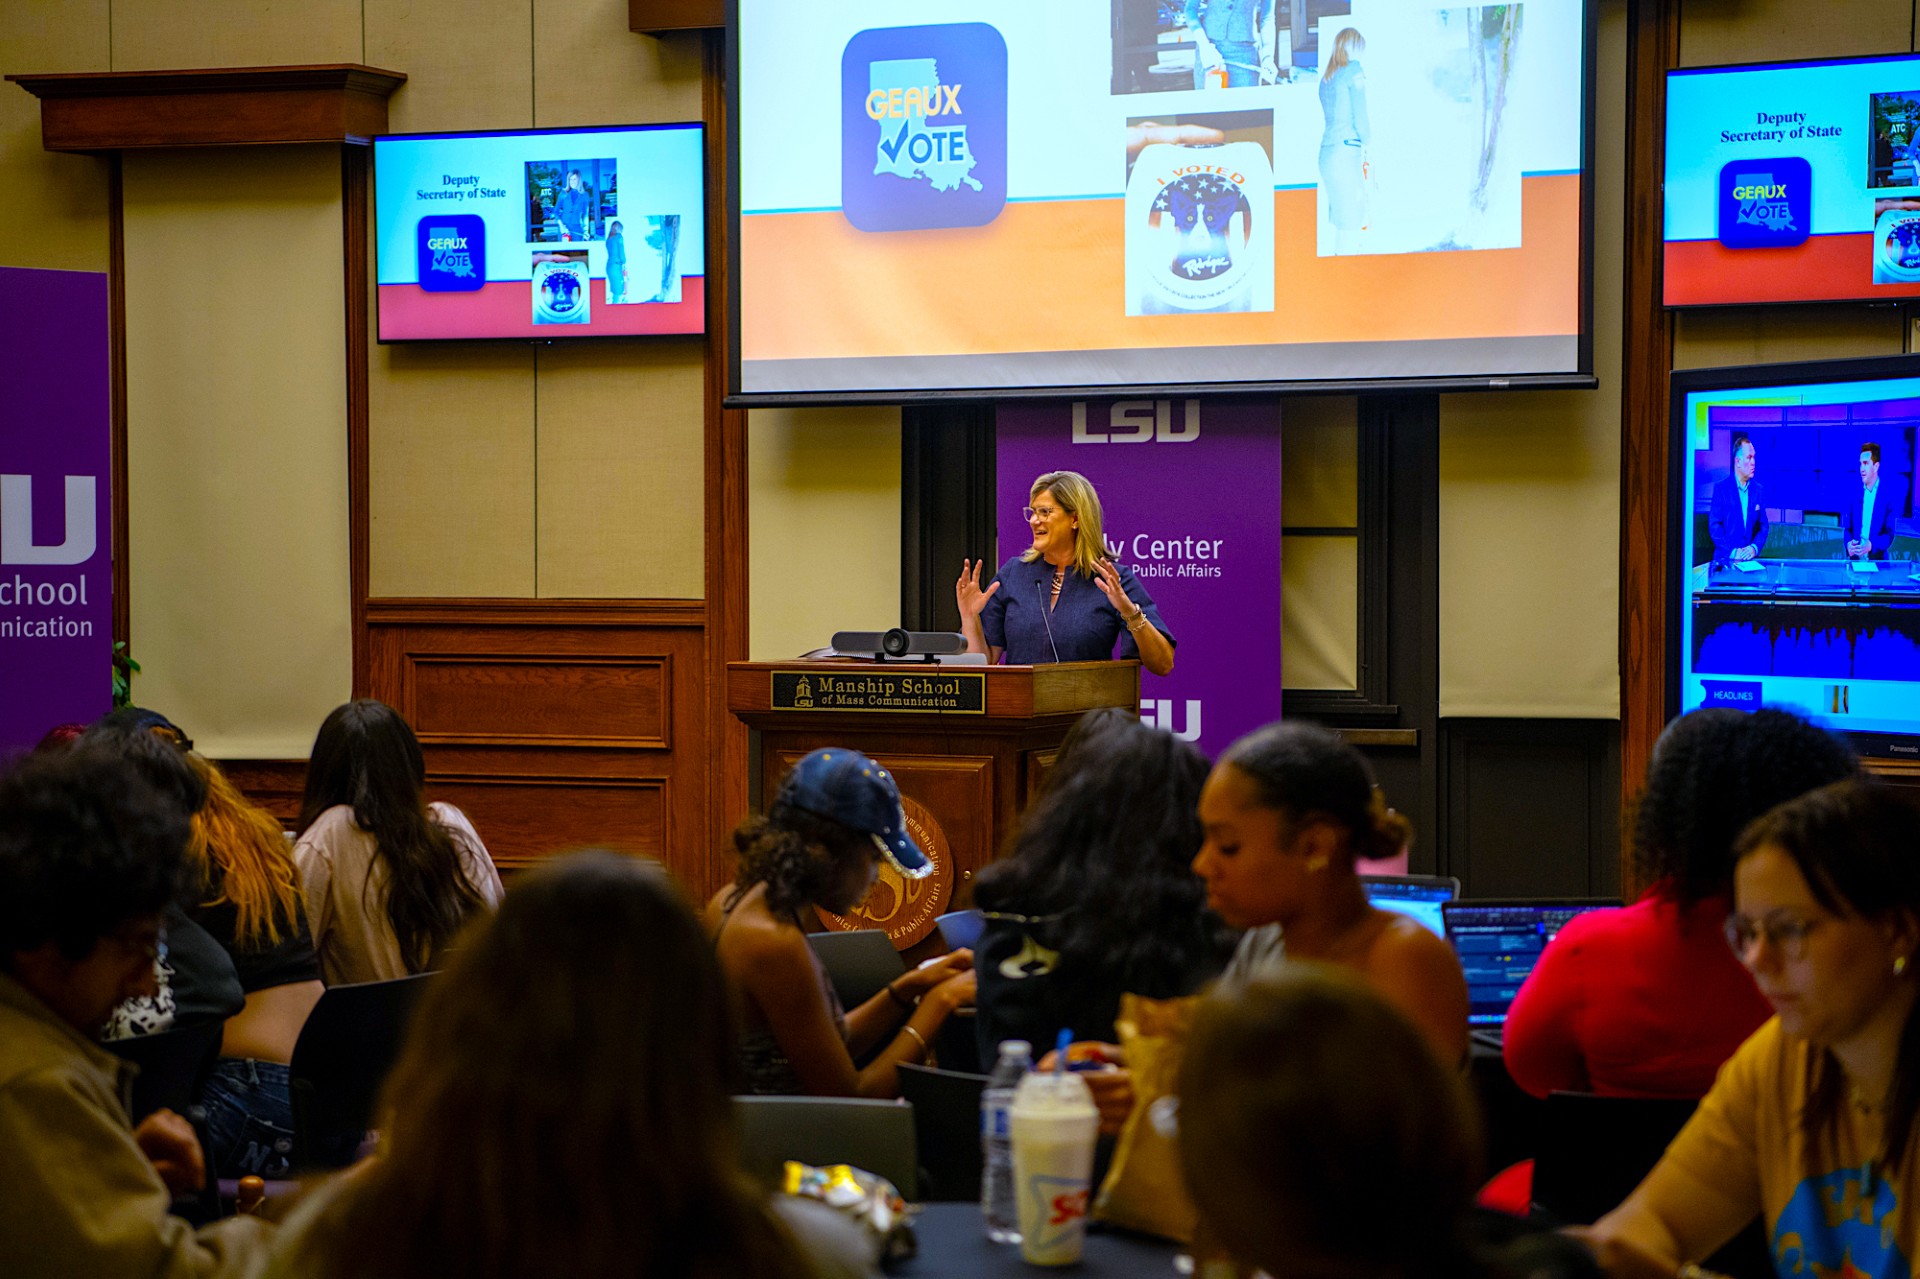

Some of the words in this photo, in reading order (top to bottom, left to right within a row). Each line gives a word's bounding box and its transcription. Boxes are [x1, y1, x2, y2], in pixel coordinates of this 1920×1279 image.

[865, 84, 962, 121] GEAUX
[1757, 112, 1806, 126] Deputy
[1720, 130, 1786, 143] Secretary
[1789, 126, 1805, 139] of
[1807, 125, 1842, 138] State
[1891, 124, 1905, 134] ATC
[442, 174, 480, 188] Deputy
[1172, 165, 1245, 185] VOTED
[416, 190, 465, 202] Secretary
[467, 188, 479, 199] of
[480, 188, 506, 199] State
[1733, 184, 1787, 200] GEAUX
[427, 237, 468, 250] GEAUX
[1072, 399, 1200, 443] LSU
[1132, 533, 1223, 560] Center
[1132, 563, 1173, 577] Public
[1177, 563, 1221, 577] Affairs
[819, 677, 895, 696] Manship
[902, 678, 960, 695] School
[795, 699, 813, 707] LSU
[822, 695, 833, 705] of
[836, 696, 864, 705] Mass
[868, 695, 957, 707] Communication
[1714, 691, 1753, 701] HEADLINES
[904, 815, 940, 876] ommunication
[900, 915, 926, 936] Public
[922, 883, 942, 915] Affairs
